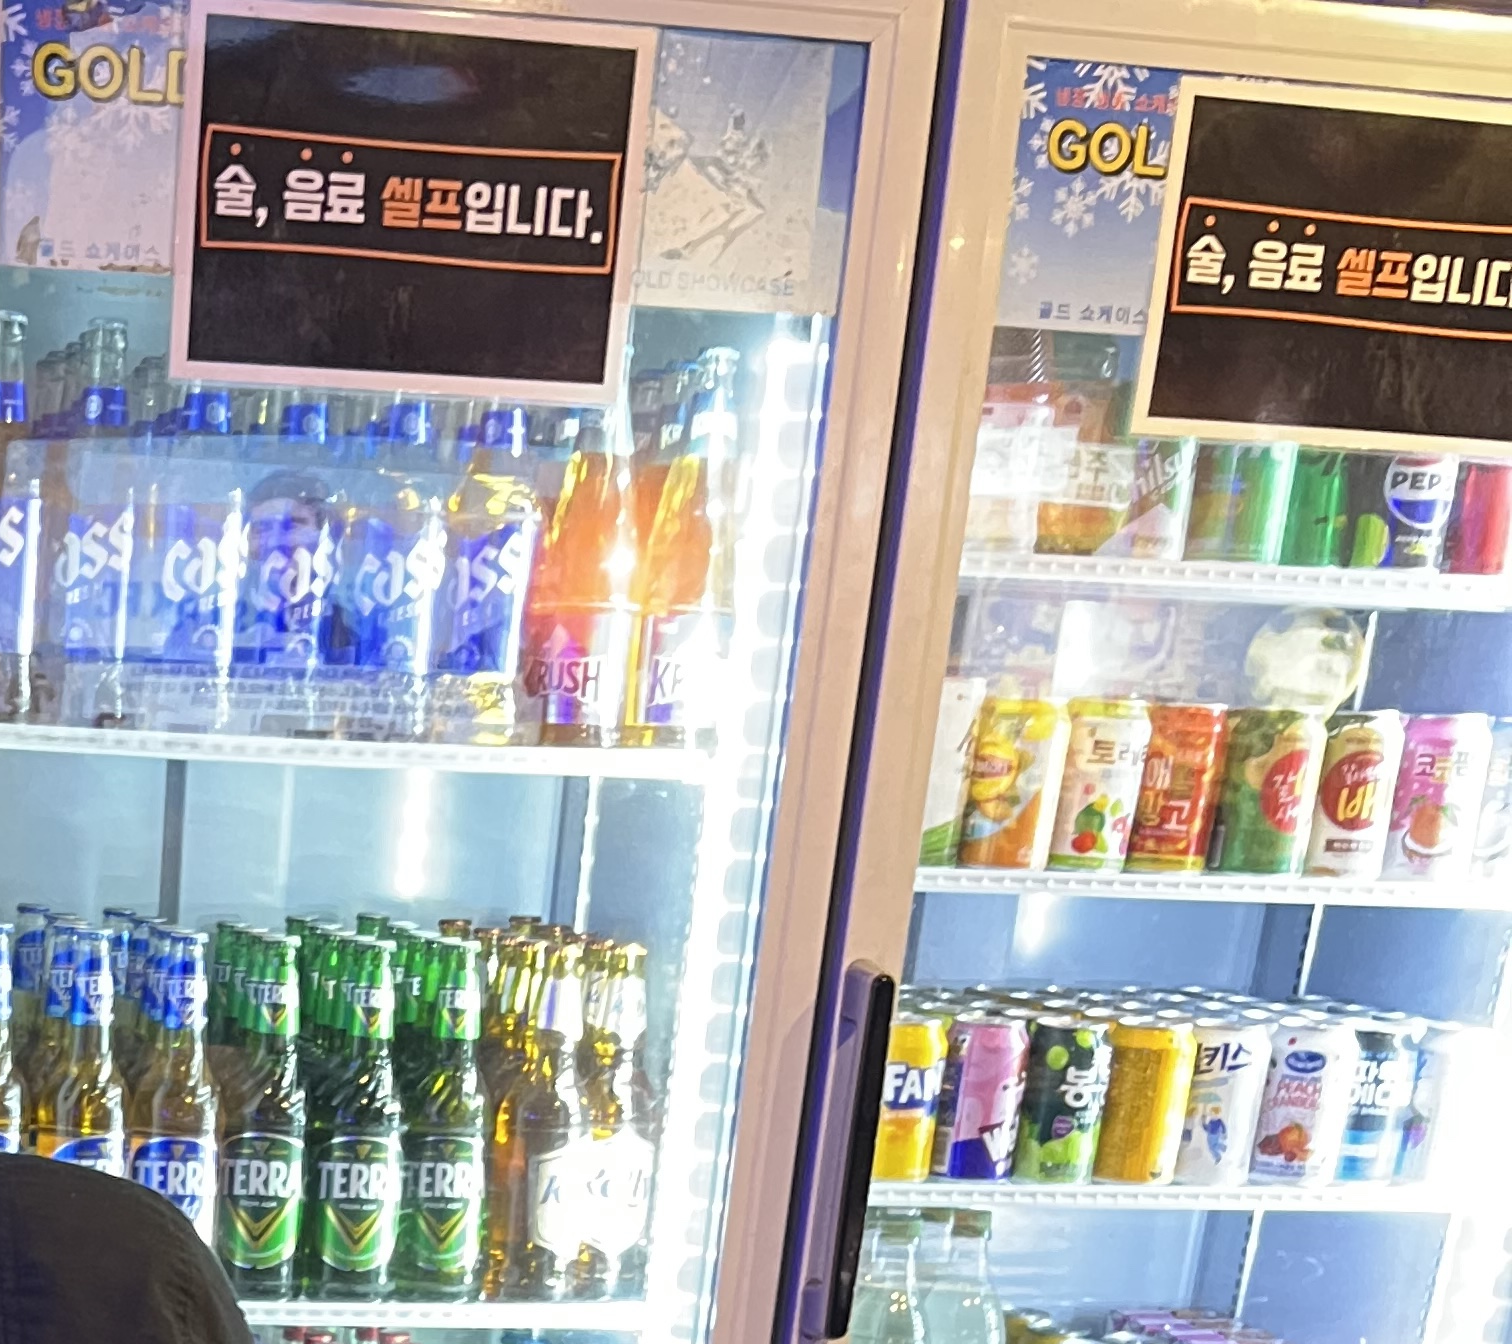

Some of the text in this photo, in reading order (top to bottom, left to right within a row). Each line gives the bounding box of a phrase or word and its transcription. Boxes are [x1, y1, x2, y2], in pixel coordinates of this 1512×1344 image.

[1048, 118, 1168, 179] GOL
[214, 164, 603, 246] 술, 음료 셀프입니다.
[85, 242, 160, 266] 쇼케이스
[1186, 233, 1236, 295] 술,
[1247, 239, 1326, 293] 음료
[678, 271, 796, 297] SHOWCASE
[1390, 470, 1448, 493] PEP
[883, 1059, 944, 1106] FAN
[136, 1160, 205, 1197] TERR
[223, 1160, 303, 1198] TERRA
[318, 1161, 393, 1200] TERR
[405, 1161, 485, 1199] TERR
